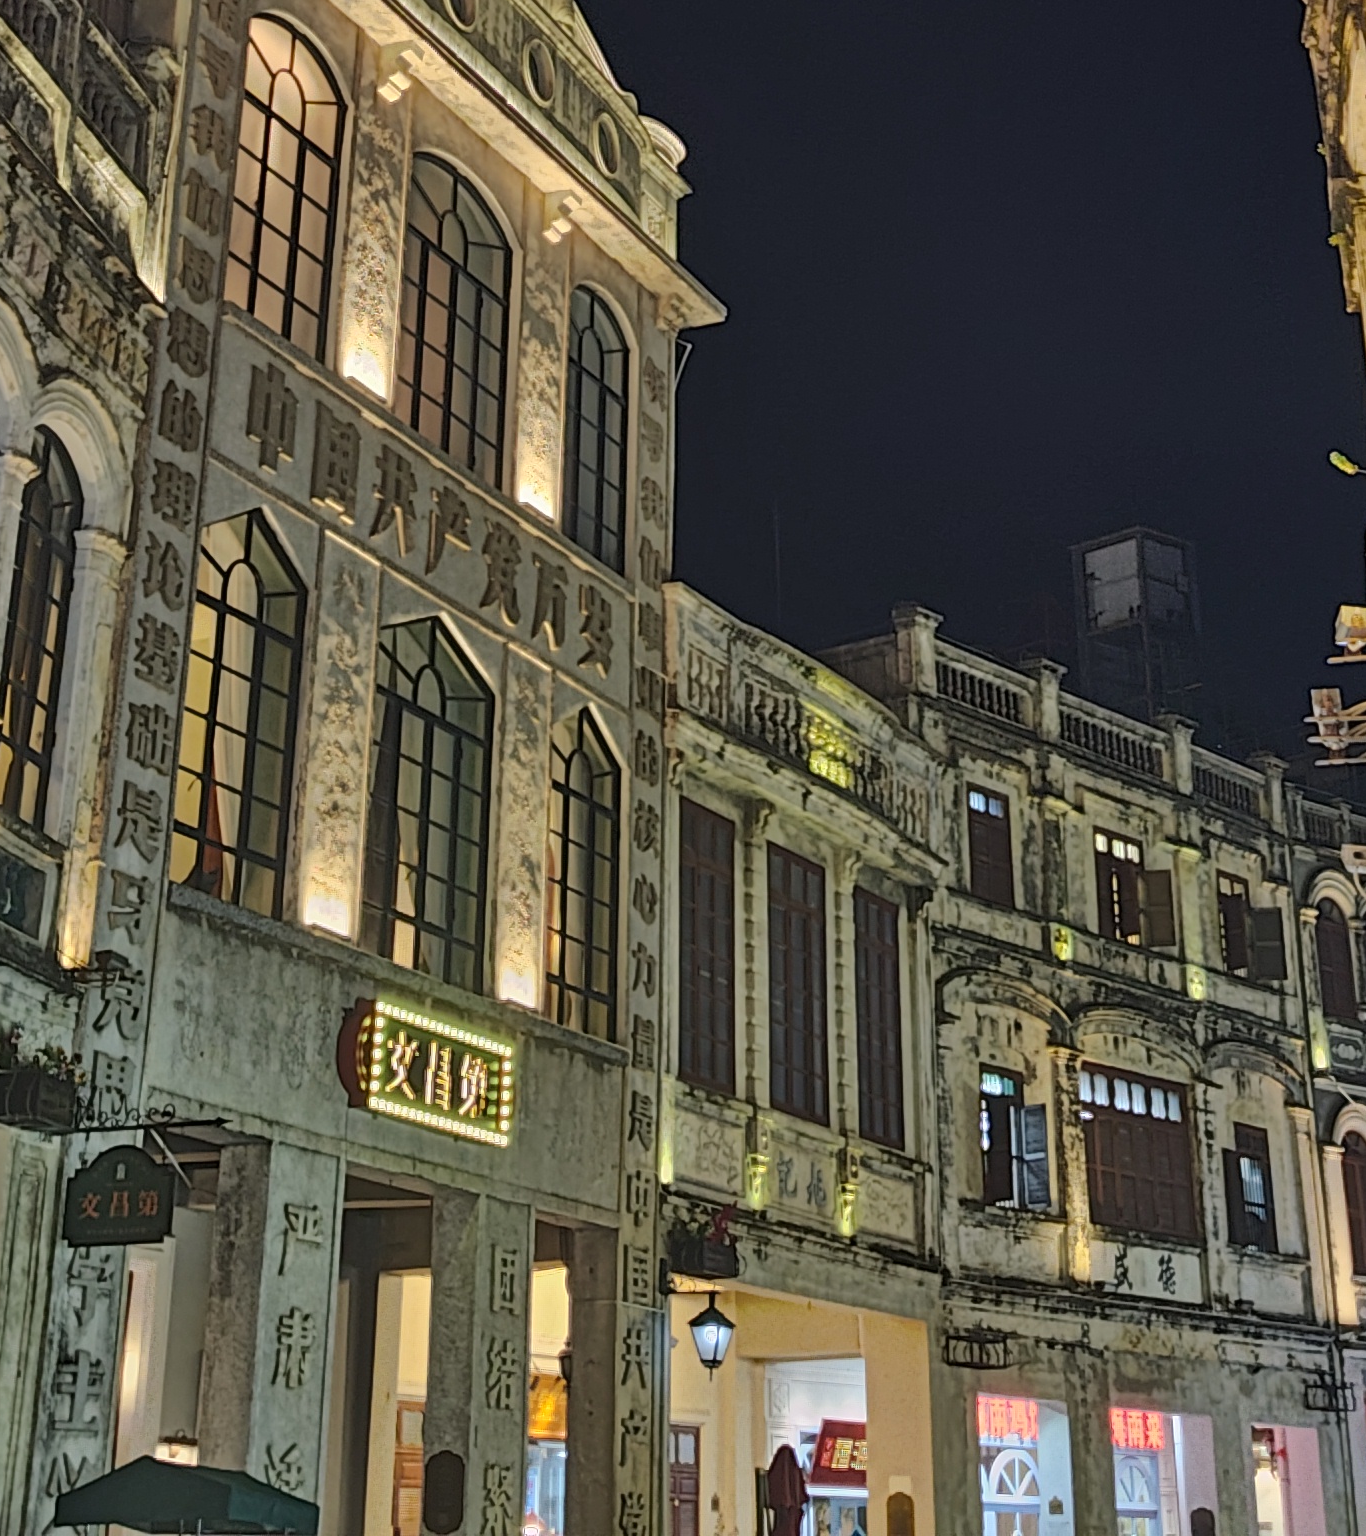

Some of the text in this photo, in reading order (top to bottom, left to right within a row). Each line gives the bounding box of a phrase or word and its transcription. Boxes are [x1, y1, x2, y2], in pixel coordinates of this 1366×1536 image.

[245, 362, 614, 680] 中国共产党万岁
[79, 1189, 159, 1219] 文昌第
